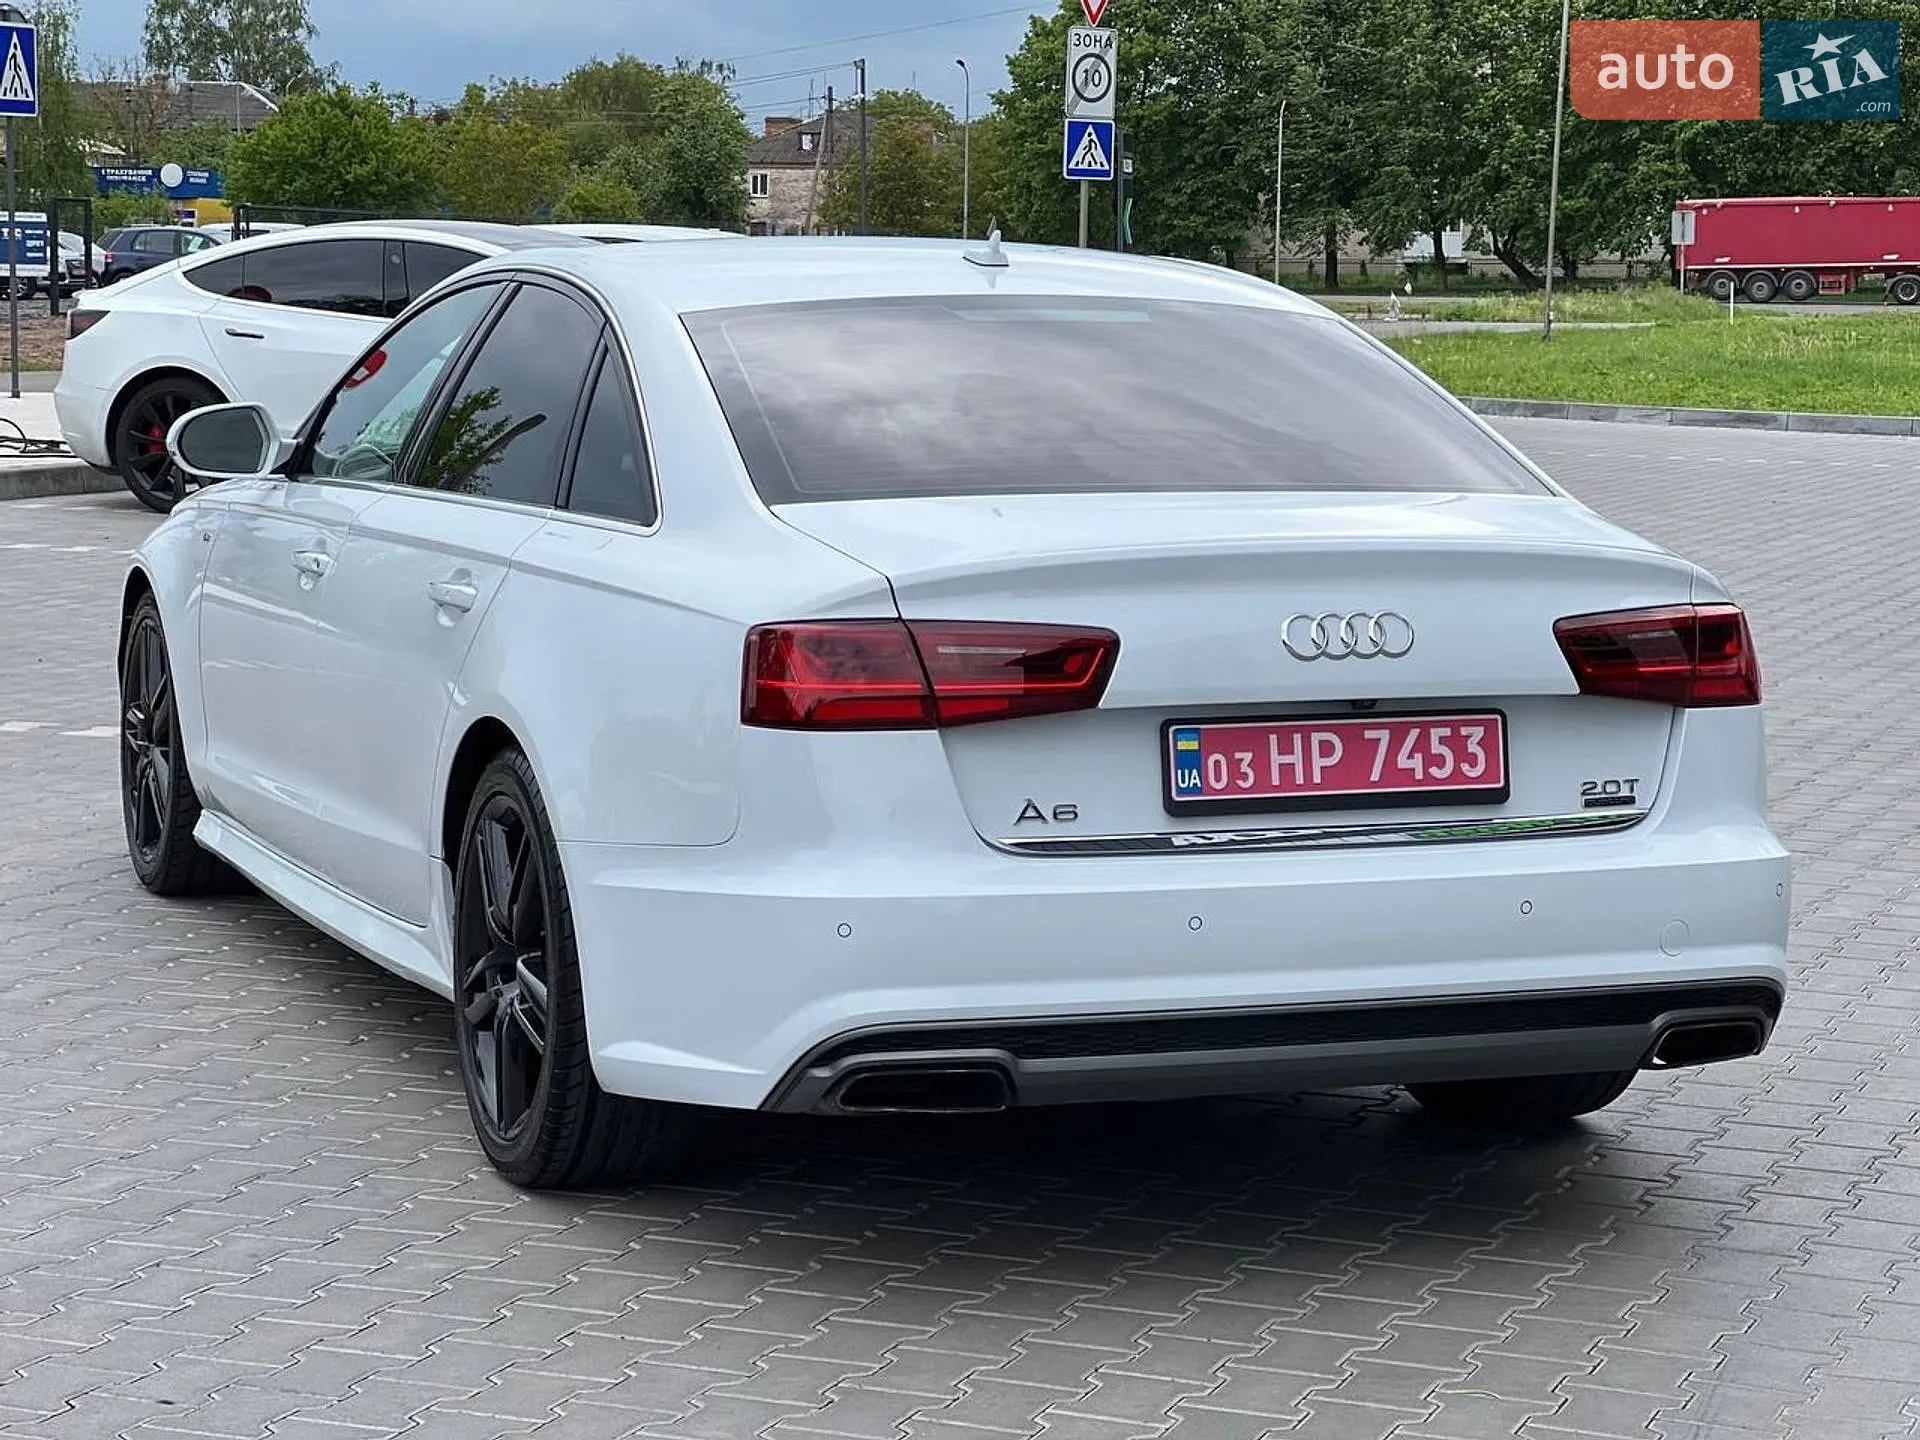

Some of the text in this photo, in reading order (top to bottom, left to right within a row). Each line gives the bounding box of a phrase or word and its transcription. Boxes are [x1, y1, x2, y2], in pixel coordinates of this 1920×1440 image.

[1073, 32, 1113, 49] ЗОНА
[1082, 68, 1102, 88] 10
[1206, 725, 1486, 790] 03 HP 7453
[1177, 768, 1202, 789] UA
[1012, 798, 1079, 827] A6
